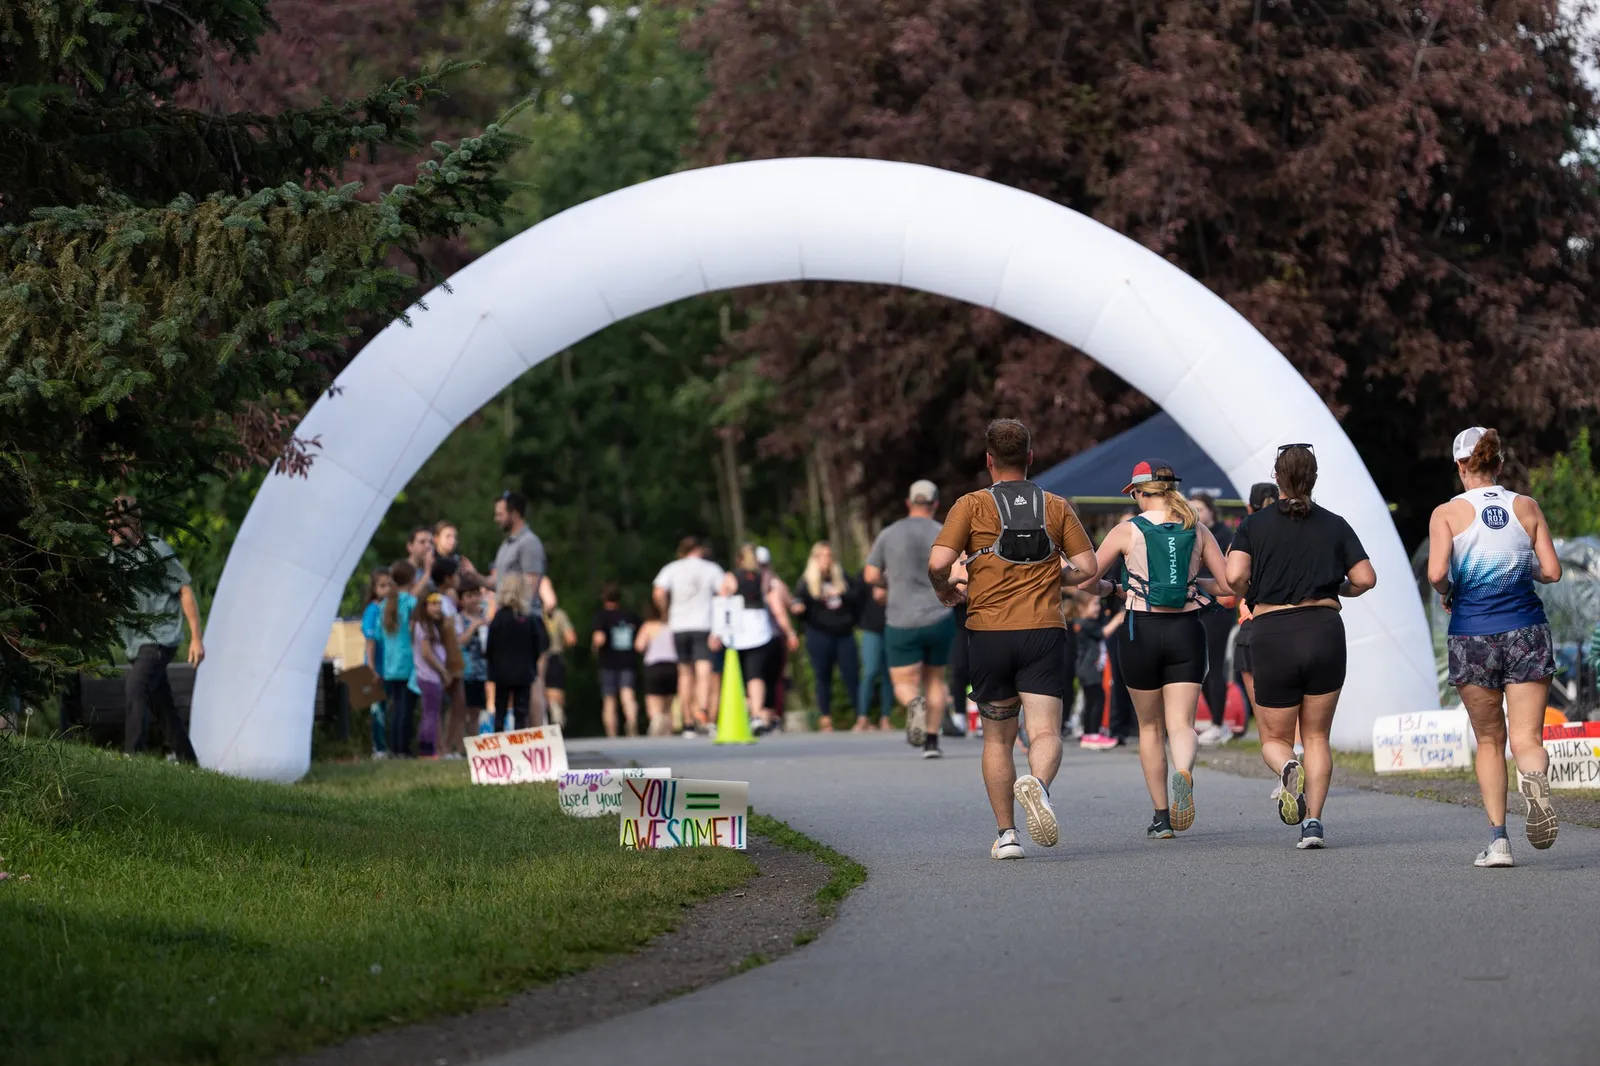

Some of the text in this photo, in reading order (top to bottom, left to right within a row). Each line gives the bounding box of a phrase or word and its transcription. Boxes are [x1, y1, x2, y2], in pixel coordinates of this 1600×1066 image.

[1168, 536, 1177, 584] NATHAN
[521, 745, 552, 774] YOU
[1546, 740, 1592, 759] CHICKS
[561, 772, 613, 787] mom
[1549, 760, 1600, 783] AMPED
[561, 789, 589, 807] used
[626, 778, 678, 820] YOU
[620, 815, 744, 850] AWESOME!!
